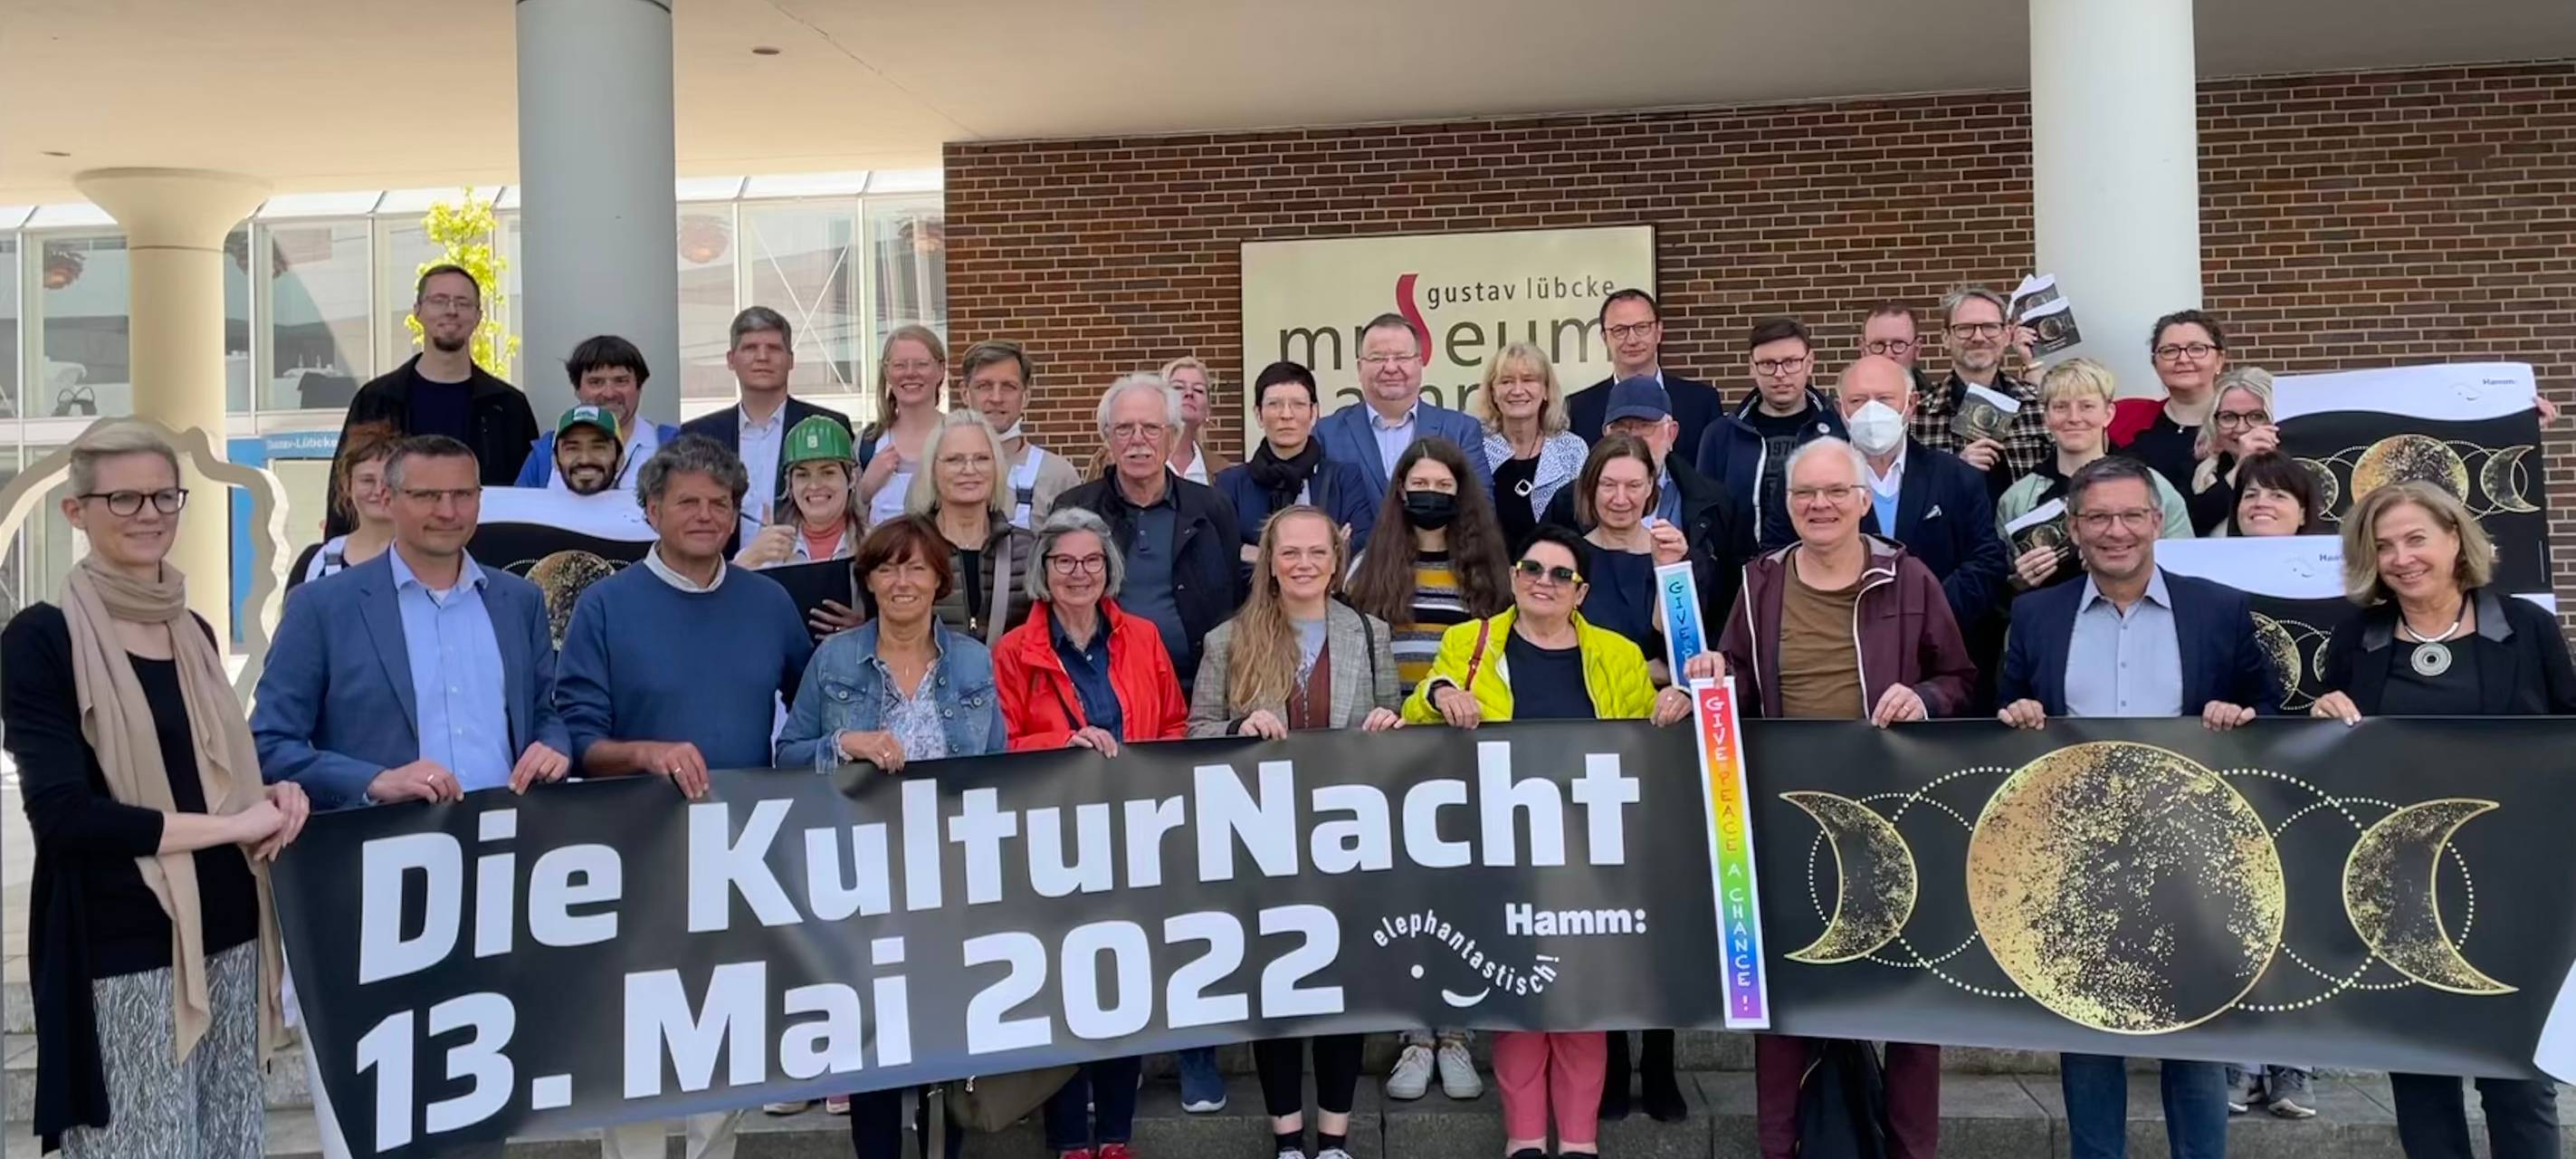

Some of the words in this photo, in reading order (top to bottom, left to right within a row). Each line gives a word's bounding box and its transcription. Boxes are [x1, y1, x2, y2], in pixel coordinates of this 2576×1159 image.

[1427, 282, 1516, 310] gustav
[1525, 274, 1616, 300] lübcke
[1668, 580, 1690, 640] GIVE
[1705, 695, 1727, 762] GIVE
[1718, 771, 1738, 852] PEACE
[359, 809, 622, 984] Die
[688, 741, 1640, 933] KulturNacht
[1727, 863, 1741, 876] A
[1372, 908, 1560, 996] elephantastisch!
[1504, 903, 1647, 935] Hamm:
[357, 992, 572, 1153] 13.
[624, 935, 912, 1099] Mai
[963, 904, 1345, 1056] 2022
